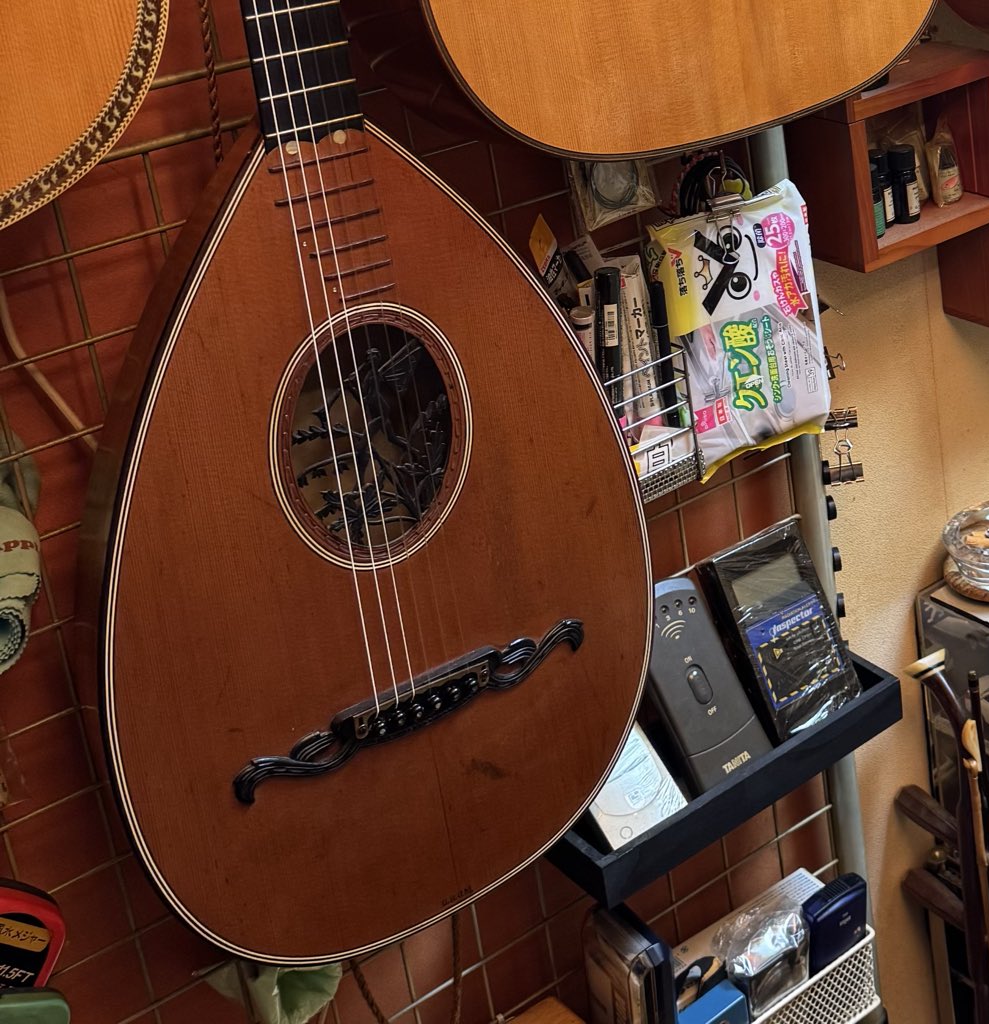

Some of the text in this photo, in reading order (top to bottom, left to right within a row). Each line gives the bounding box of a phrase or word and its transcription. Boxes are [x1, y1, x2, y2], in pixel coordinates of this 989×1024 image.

[722, 323, 767, 408] クエン酸
[684, 656, 693, 665] ON
[707, 706, 718, 716] OFF
[722, 751, 751, 774] TANITA
